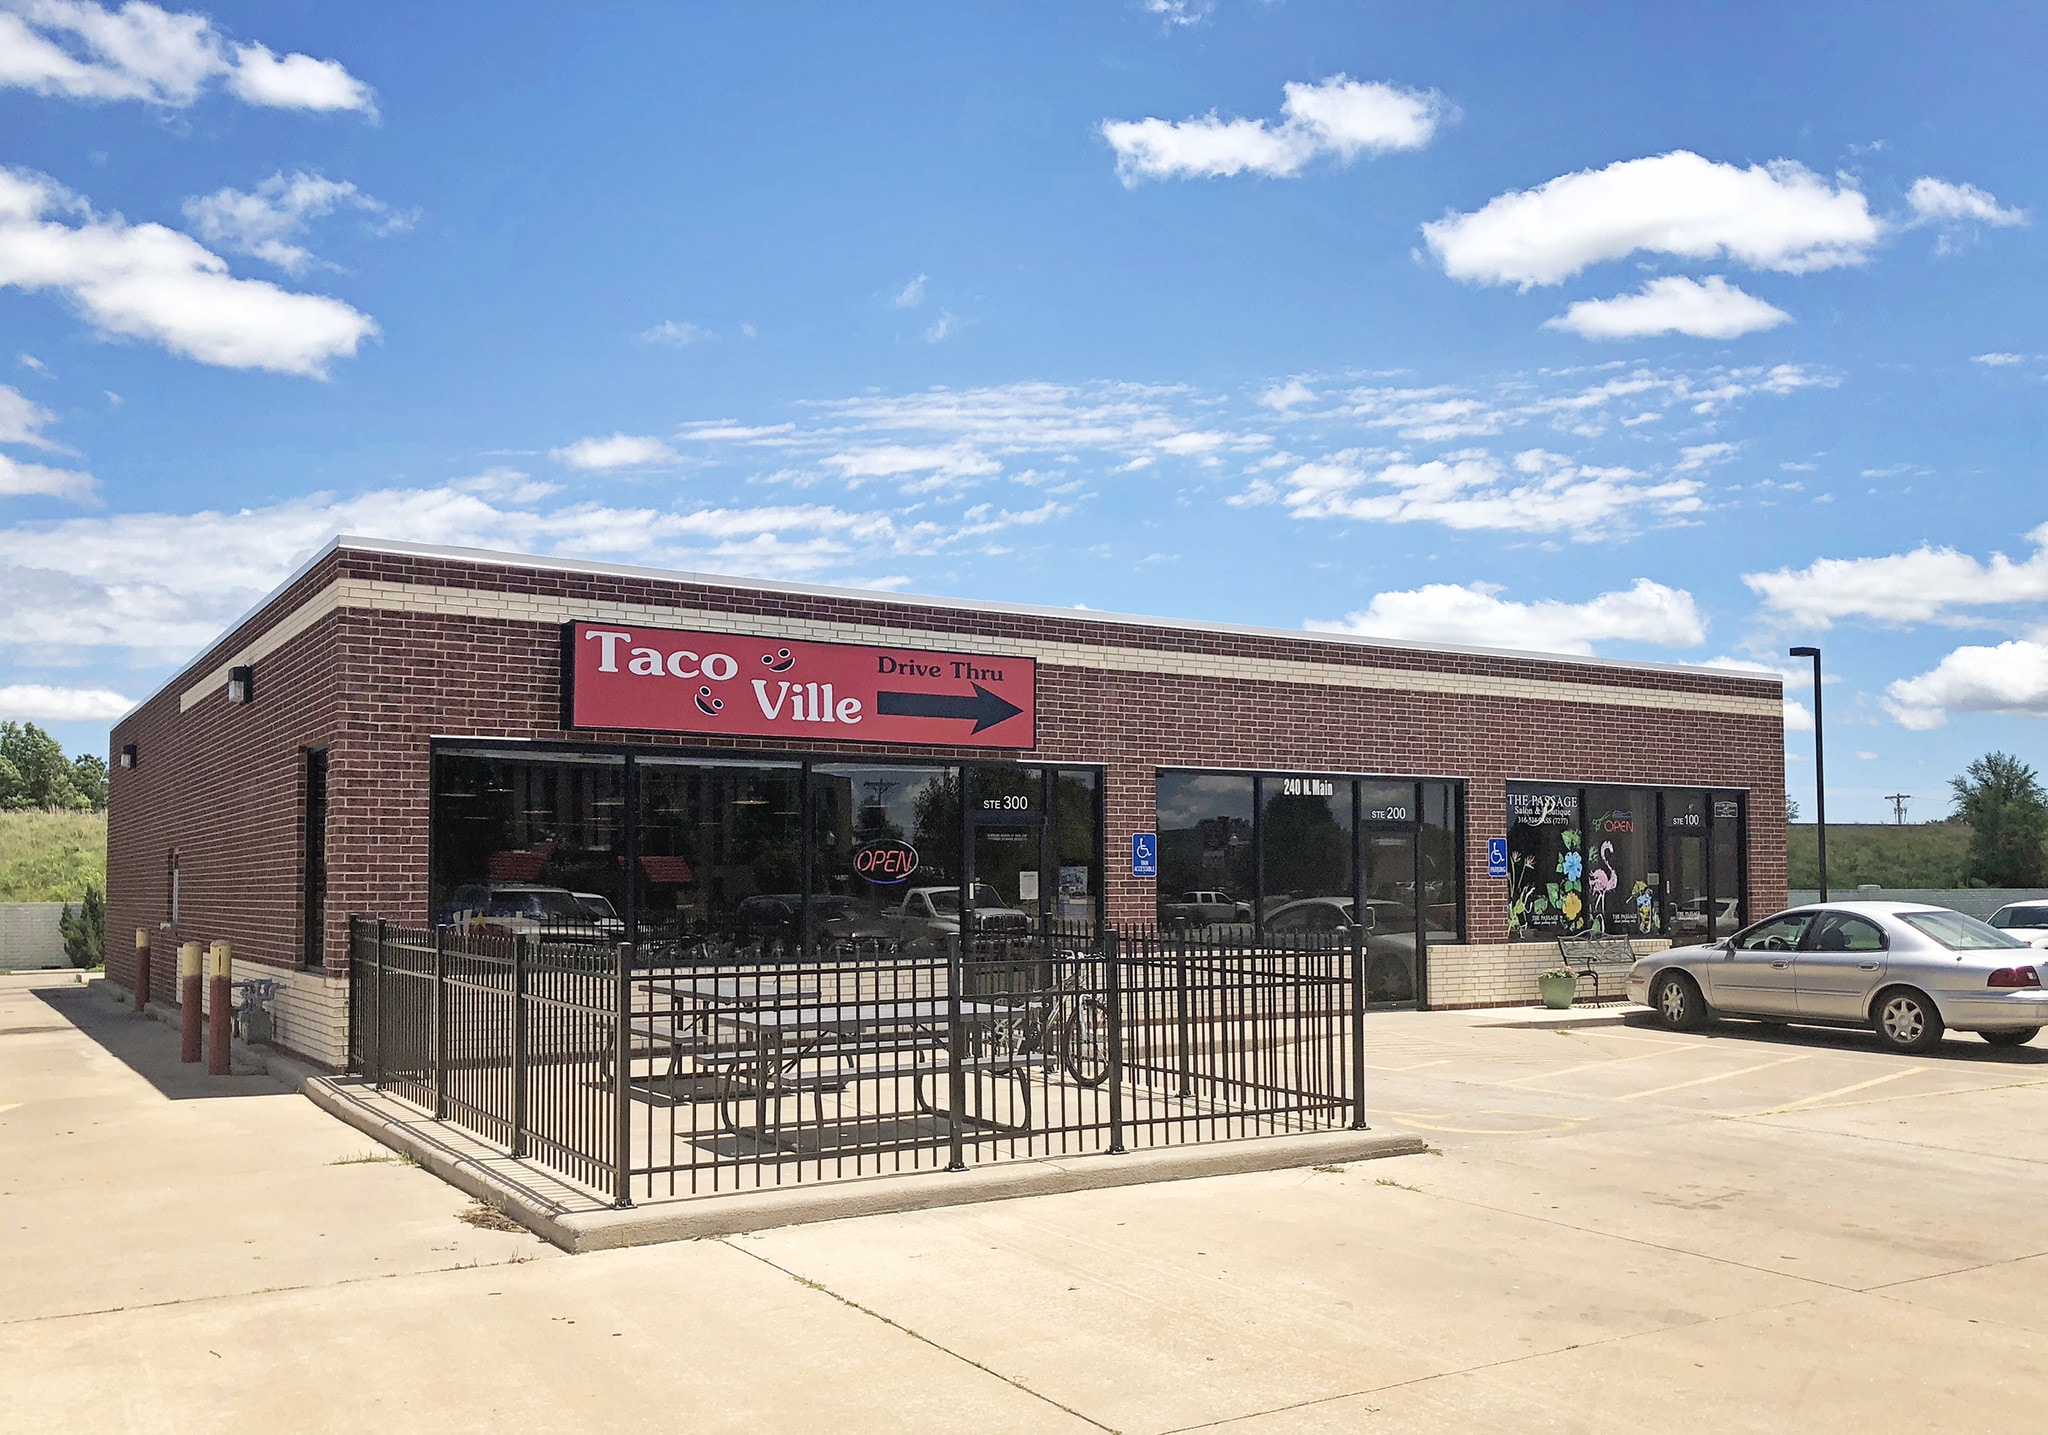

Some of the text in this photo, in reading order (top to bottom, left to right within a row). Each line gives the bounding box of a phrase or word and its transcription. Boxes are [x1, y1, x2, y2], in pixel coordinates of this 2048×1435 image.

[585, 630, 739, 682] Taco
[877, 655, 1004, 682] Drive Thru
[750, 679, 863, 725] Ville
[1283, 778, 1333, 796] 240 N. Main
[983, 795, 1028, 810] STE 300
[1507, 794, 1578, 808] THE PASSAGE
[1371, 806, 1406, 820] STE 200
[1514, 805, 1533, 815] Salon
[1542, 806, 1571, 818] outique
[1604, 819, 1634, 833] OPEN
[1672, 814, 1699, 826] STE 100
[857, 850, 913, 872] OPEN
